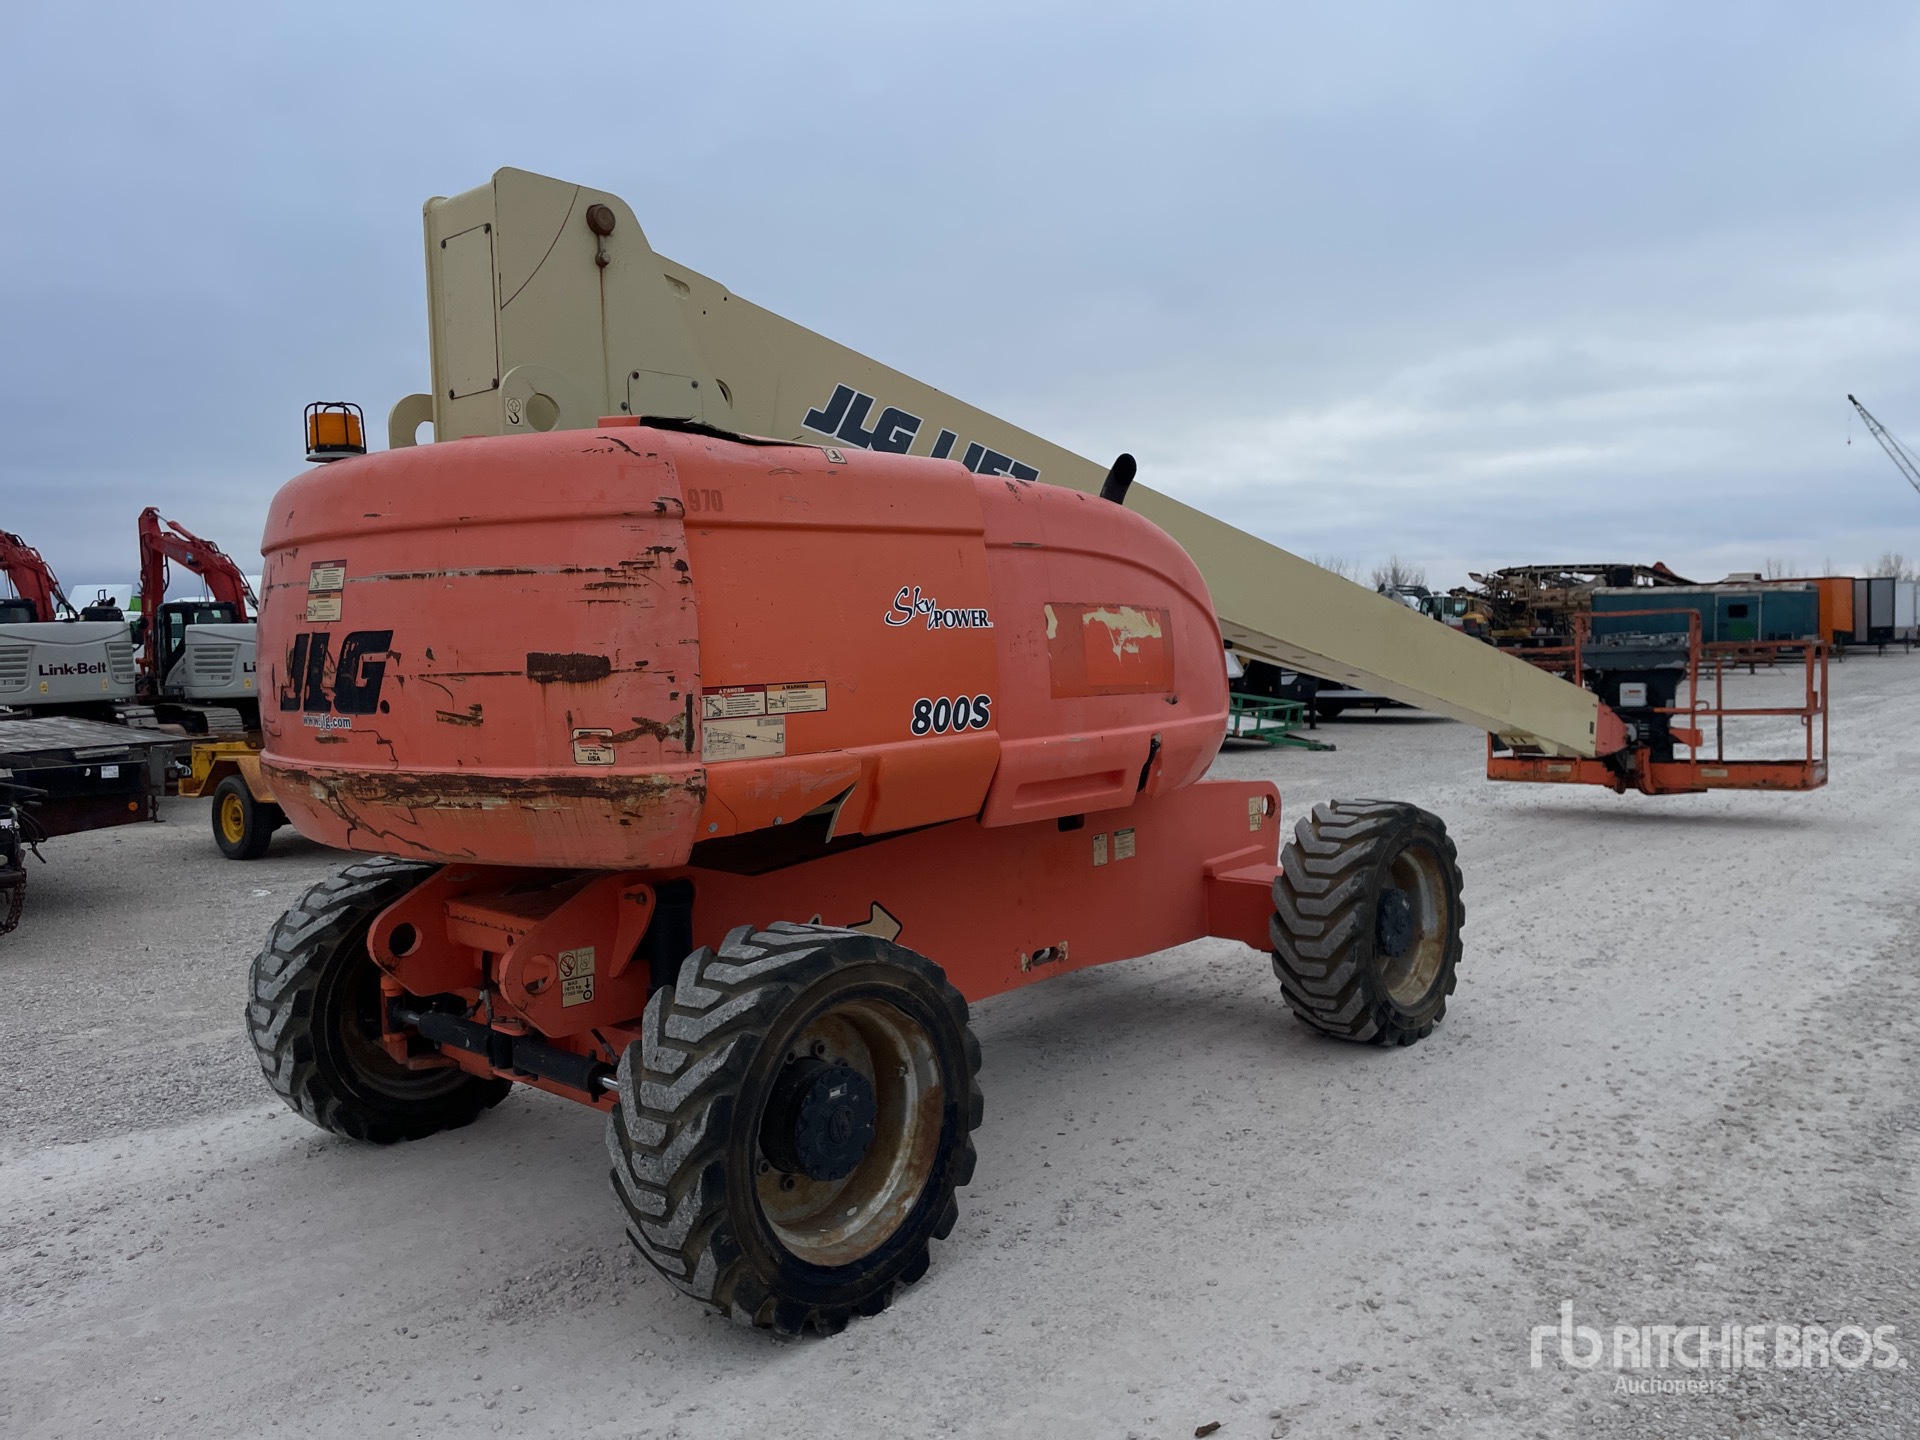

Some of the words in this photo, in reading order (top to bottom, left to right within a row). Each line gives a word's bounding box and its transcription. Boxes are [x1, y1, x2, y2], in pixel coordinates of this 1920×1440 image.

[801, 382, 924, 454] JLG
[687, 488, 724, 512] 970
[38, 661, 107, 677] Link-Belt
[303, 714, 351, 730] www.jlg.com
[911, 694, 992, 736] 800S
